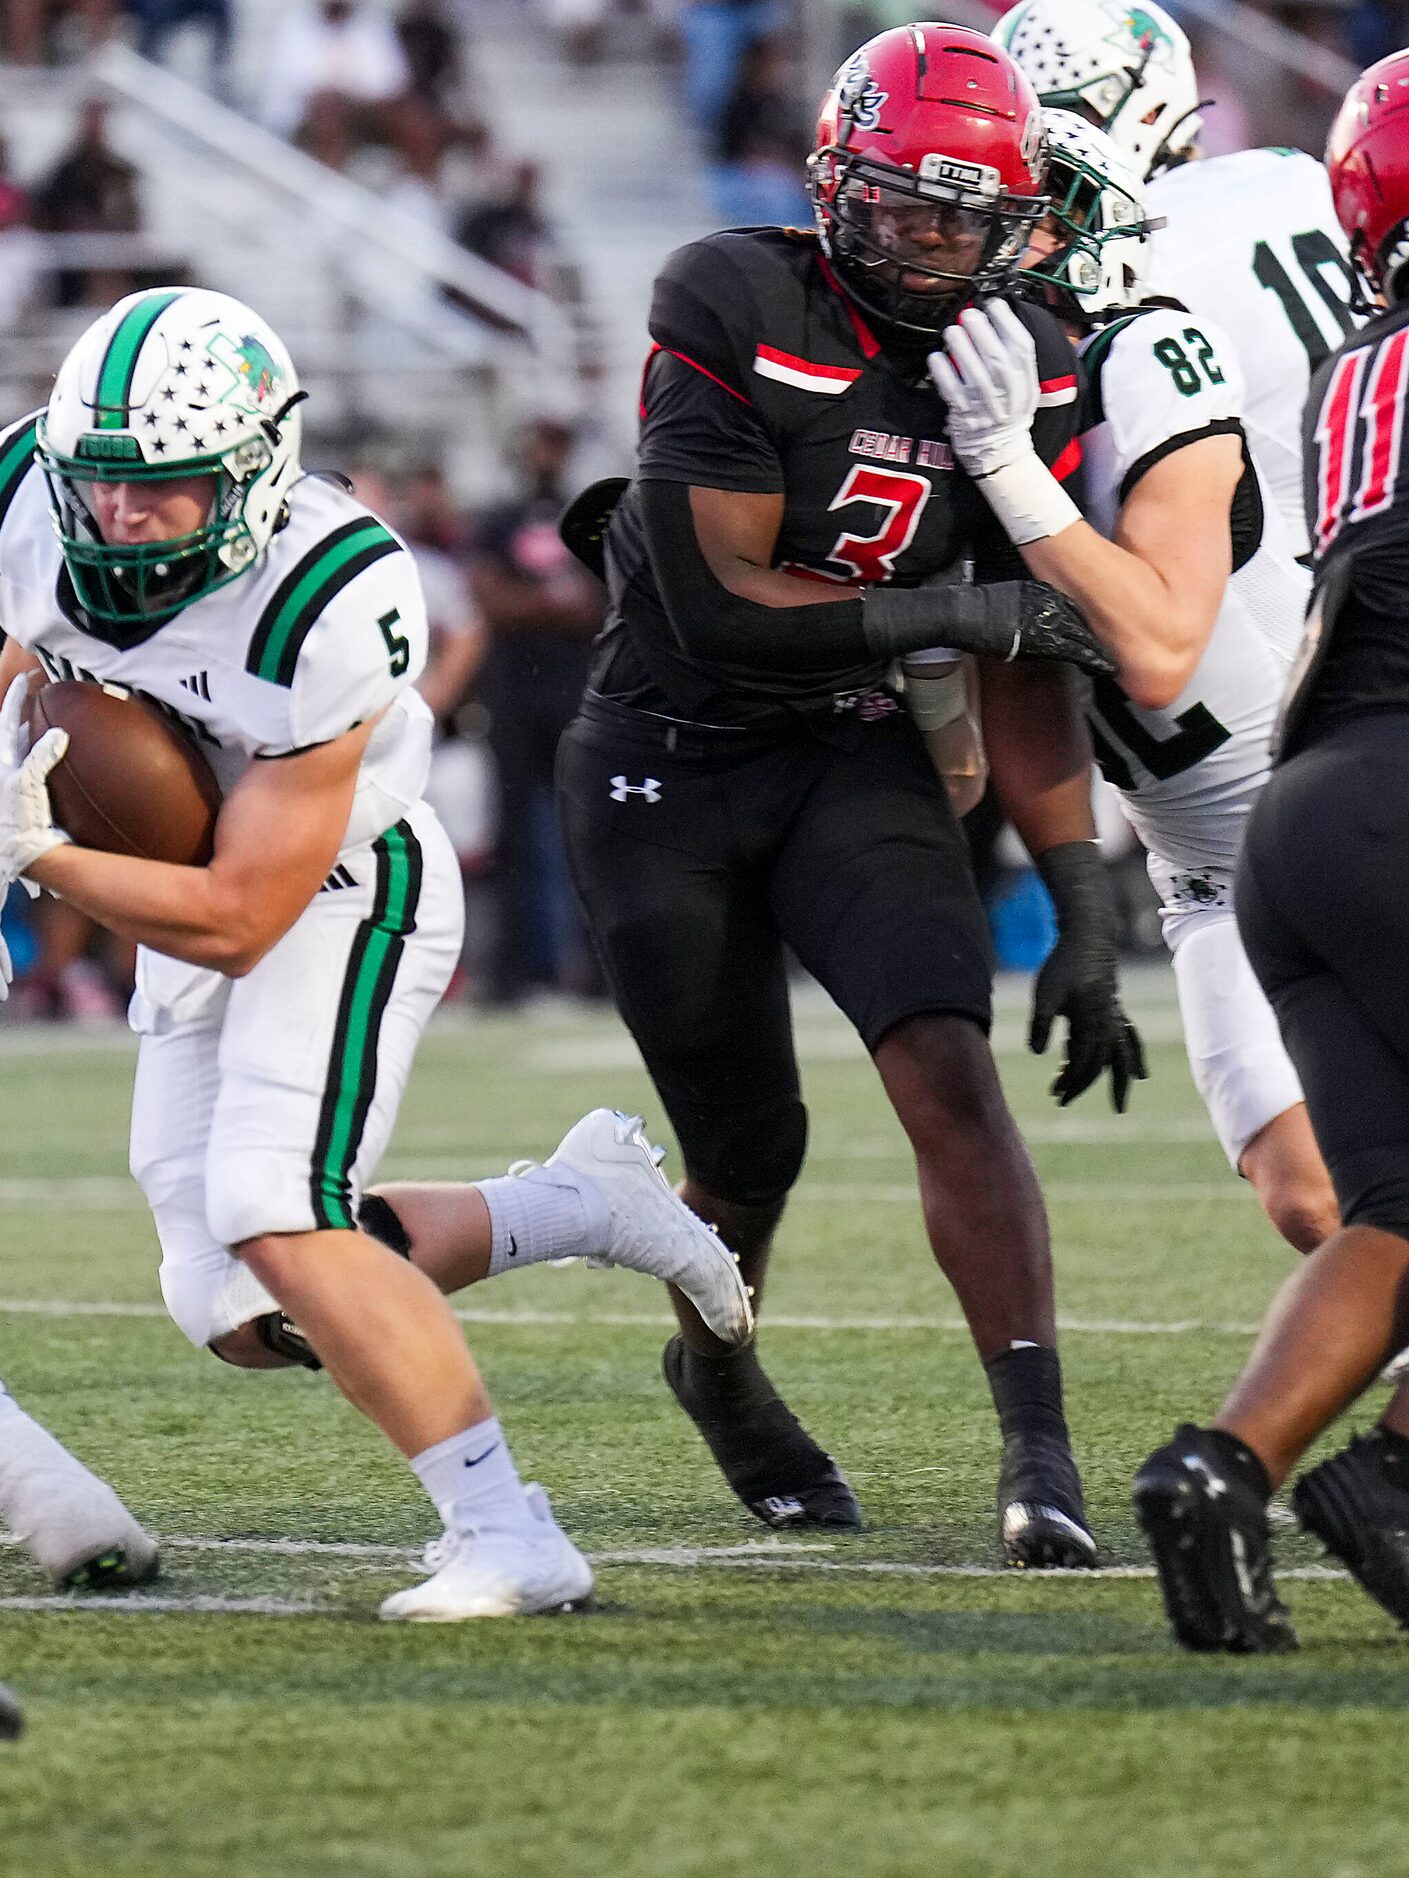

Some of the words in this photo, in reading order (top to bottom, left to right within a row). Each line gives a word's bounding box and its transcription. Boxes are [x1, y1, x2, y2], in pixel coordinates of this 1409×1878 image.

[1152, 326, 1228, 398] 82
[848, 428, 914, 464] CEDAR
[1312, 325, 1409, 559] 11
[781, 462, 933, 587] 3
[376, 605, 410, 679] 5
